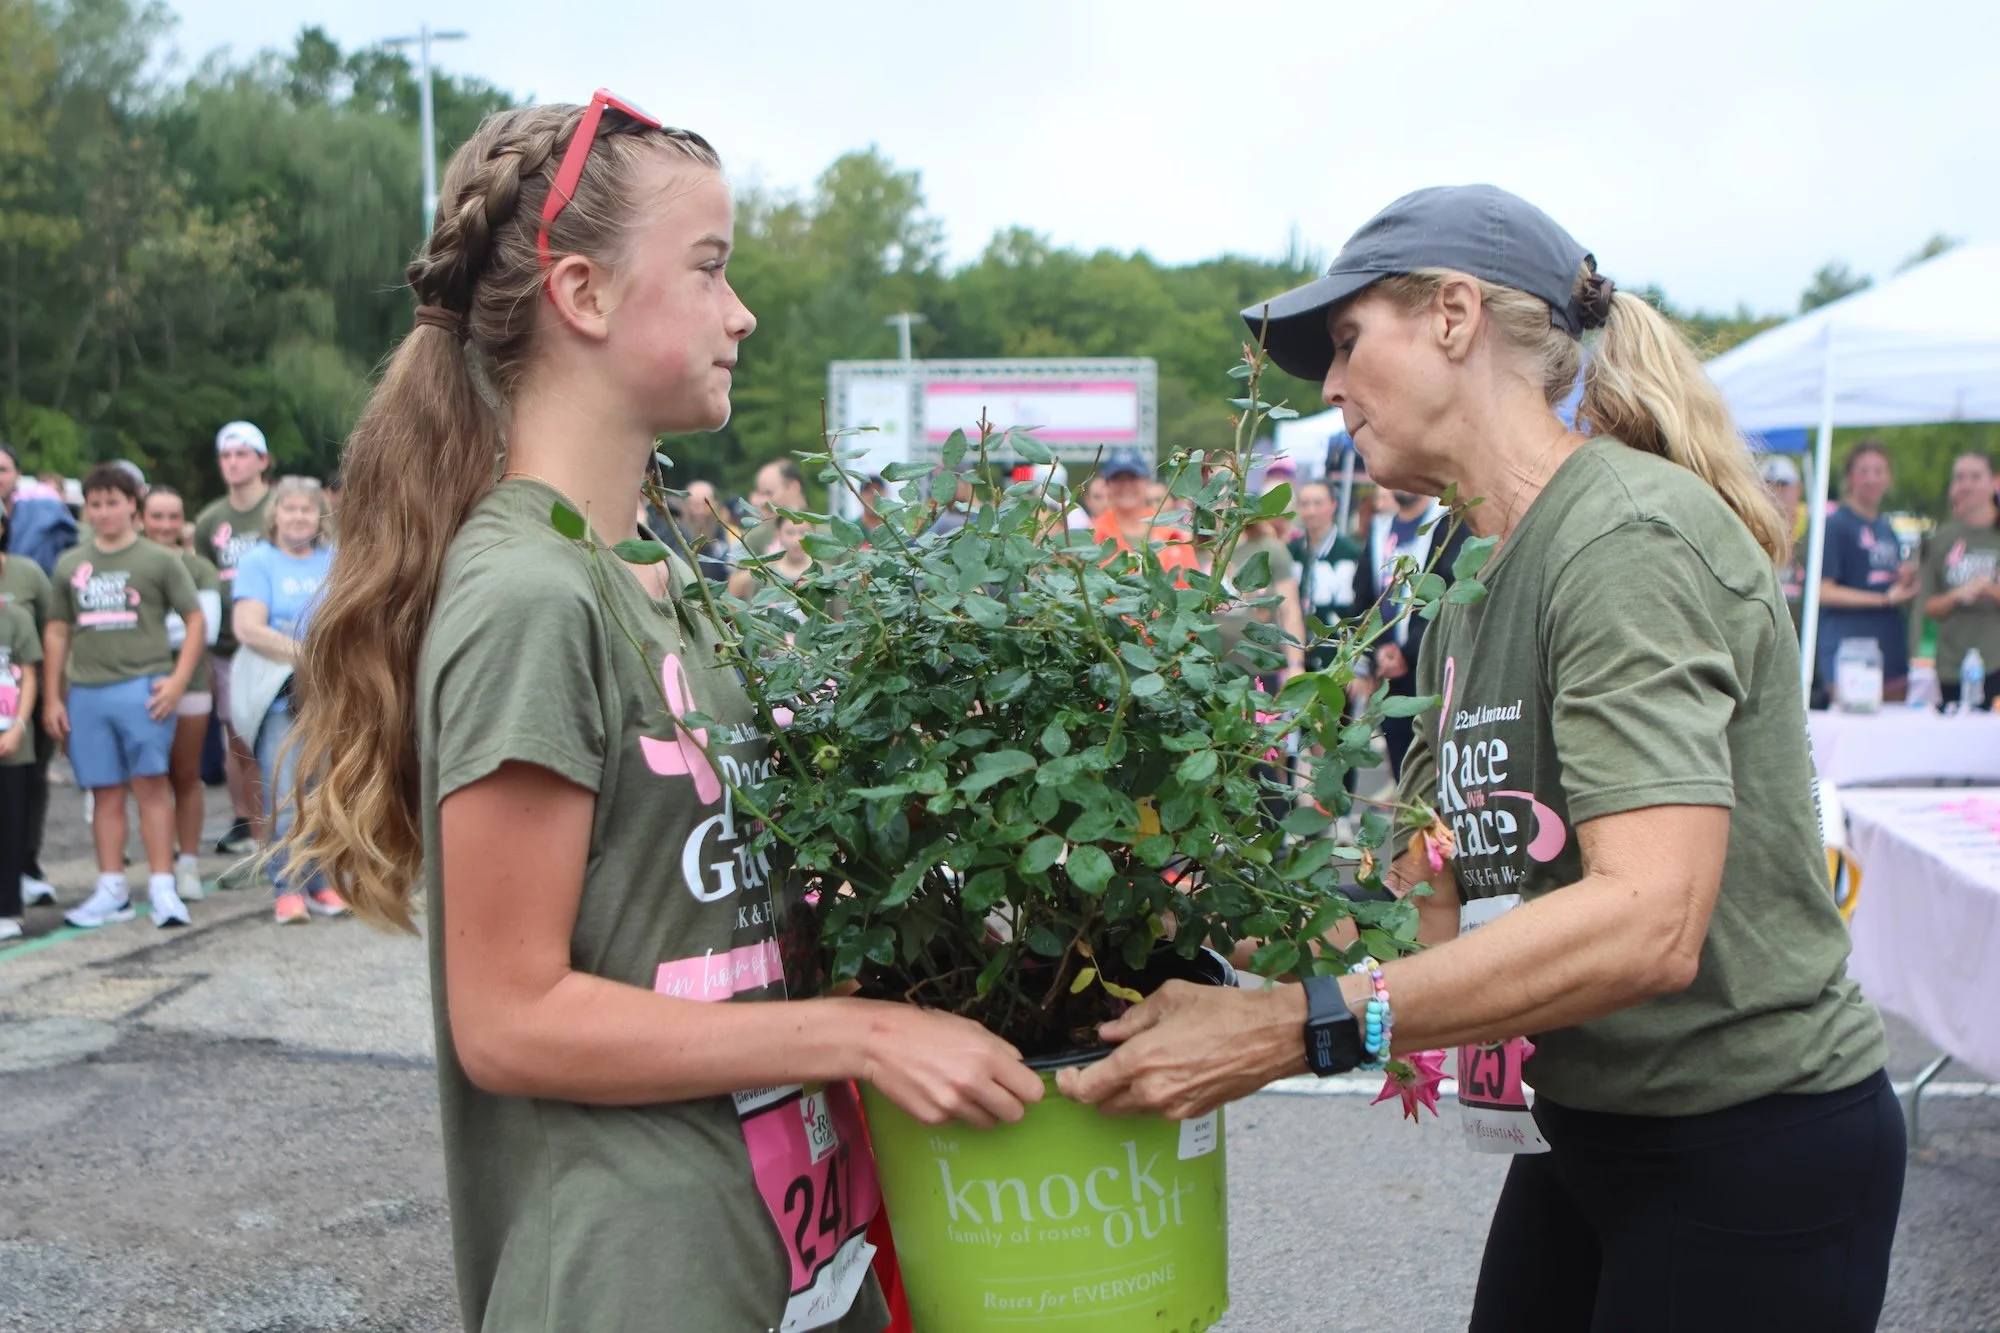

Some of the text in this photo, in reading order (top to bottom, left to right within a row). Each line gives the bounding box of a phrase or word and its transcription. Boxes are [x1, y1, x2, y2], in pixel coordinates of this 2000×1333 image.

[1455, 699, 1522, 731] 22nd Annual
[1437, 738, 1509, 815] Race
[1450, 809, 1518, 861] race
[929, 1135, 959, 1153] the
[935, 1139, 1165, 1225] knock
[947, 1223, 1092, 1249] family of roses
[1103, 1175, 1187, 1249] out
[983, 1262, 1177, 1314] Roses for EVERYONE
